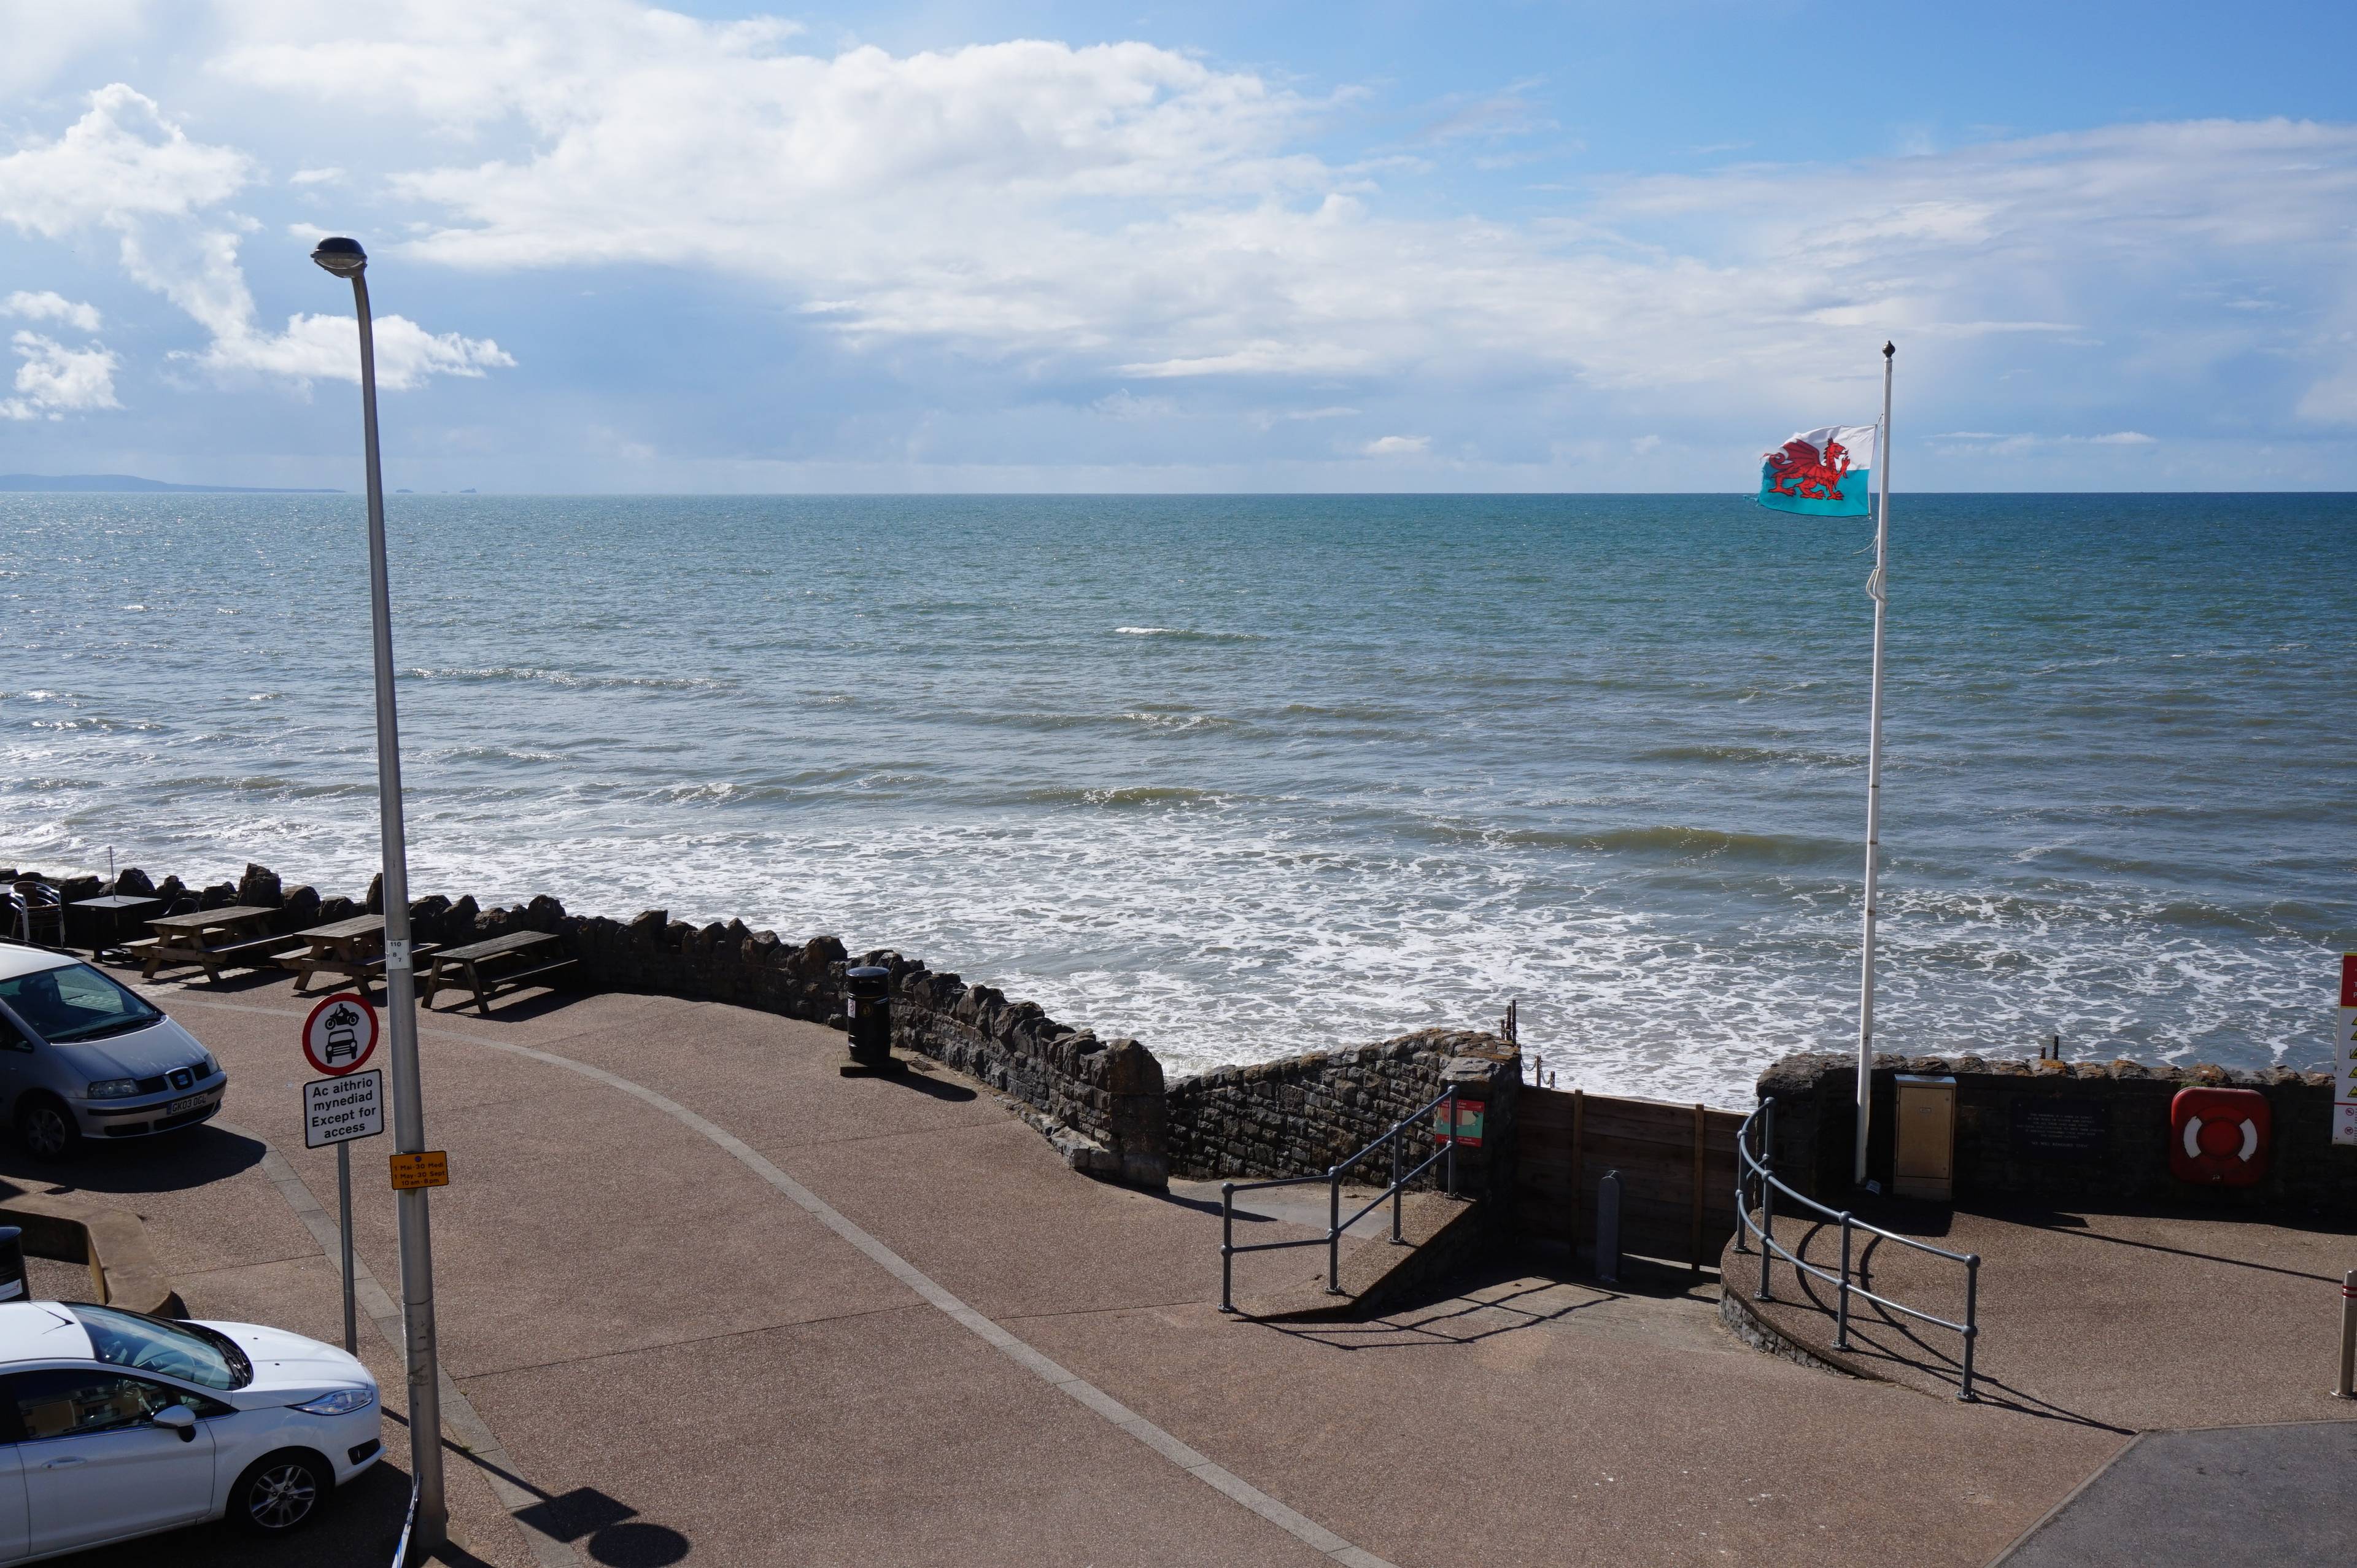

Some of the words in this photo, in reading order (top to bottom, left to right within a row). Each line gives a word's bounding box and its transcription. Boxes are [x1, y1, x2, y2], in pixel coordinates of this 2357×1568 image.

[312, 1086, 328, 1098] Ac
[333, 1078, 373, 1094] aithrio
[314, 1090, 373, 1111] mynediad
[312, 1110, 355, 1127] Except
[358, 1107, 376, 1118] for
[324, 1122, 365, 1138] access
